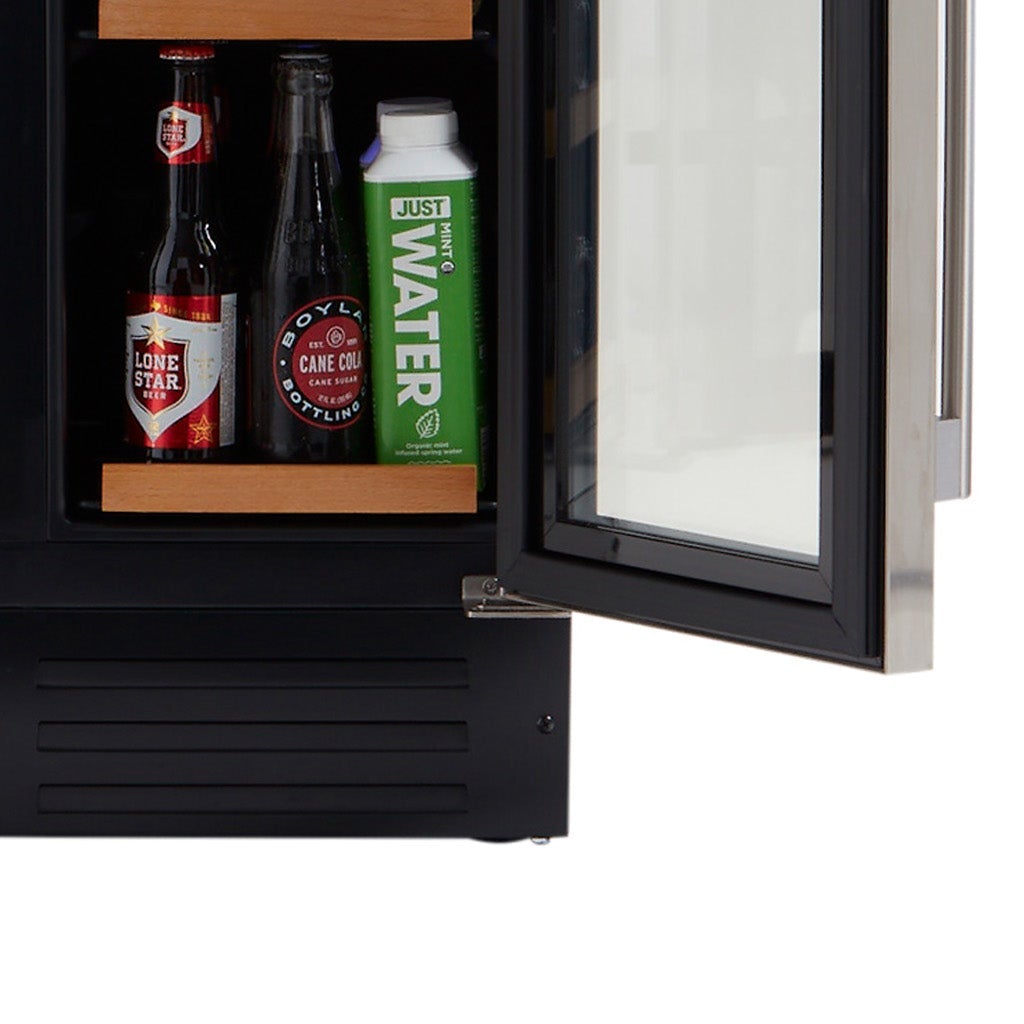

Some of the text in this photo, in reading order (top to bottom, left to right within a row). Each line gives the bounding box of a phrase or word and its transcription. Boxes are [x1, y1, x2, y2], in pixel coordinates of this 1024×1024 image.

[397, 199, 444, 217] JUST
[440, 222, 453, 259] MINT
[281, 301, 367, 349] BOYLA
[391, 222, 442, 408] WATER
[135, 351, 179, 372] LONE
[299, 354, 335, 374] CANE
[134, 370, 180, 391] STAR
[308, 379, 333, 387] CANE
